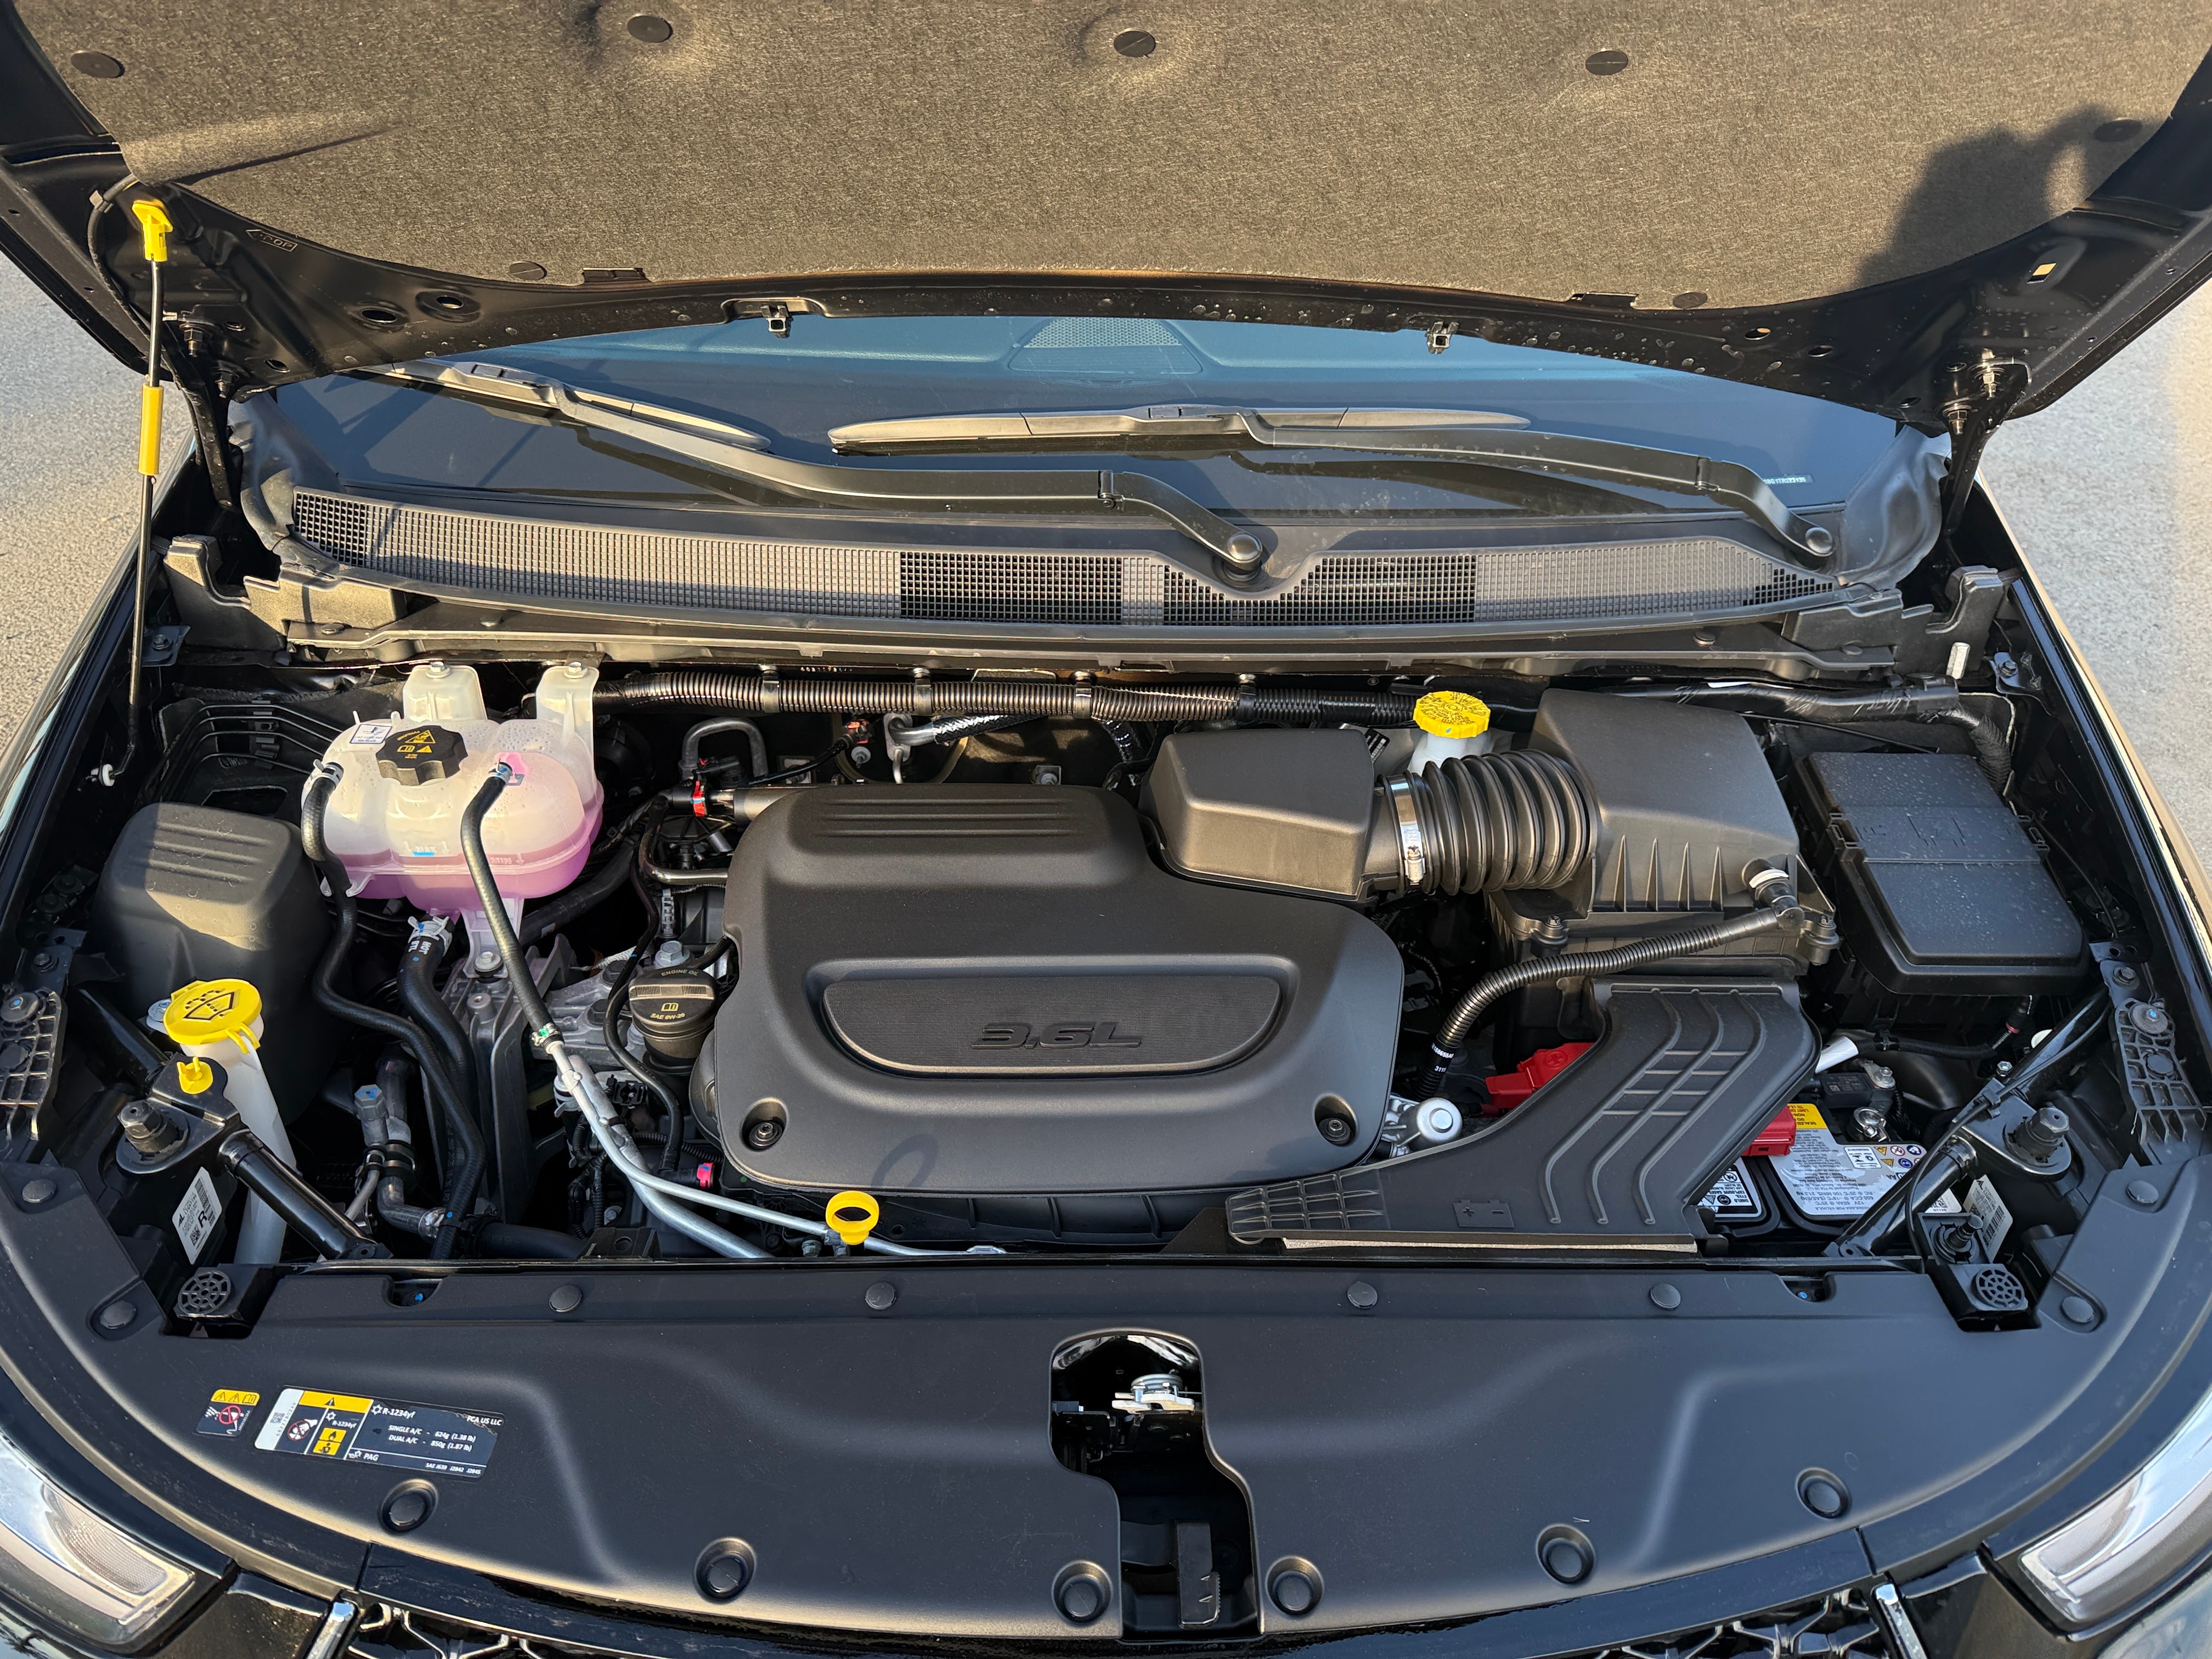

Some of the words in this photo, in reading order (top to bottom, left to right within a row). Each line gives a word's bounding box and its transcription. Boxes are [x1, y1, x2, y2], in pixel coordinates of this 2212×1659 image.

[419, 941, 432, 955] HOT
[971, 1022, 1142, 1048] 3.6L
[198, 1210, 207, 1228] R
[382, 1408, 416, 1419] R-1234yf
[331, 1420, 357, 1429] R-1234yf
[435, 1431, 450, 1440] 624g
[451, 1433, 467, 1441] (1.38
[466, 1435, 476, 1443] lb)
[431, 1440, 446, 1449] 850g
[447, 1442, 464, 1450] (1.87
[462, 1444, 472, 1452] lb)
[363, 1453, 379, 1462] PAG
